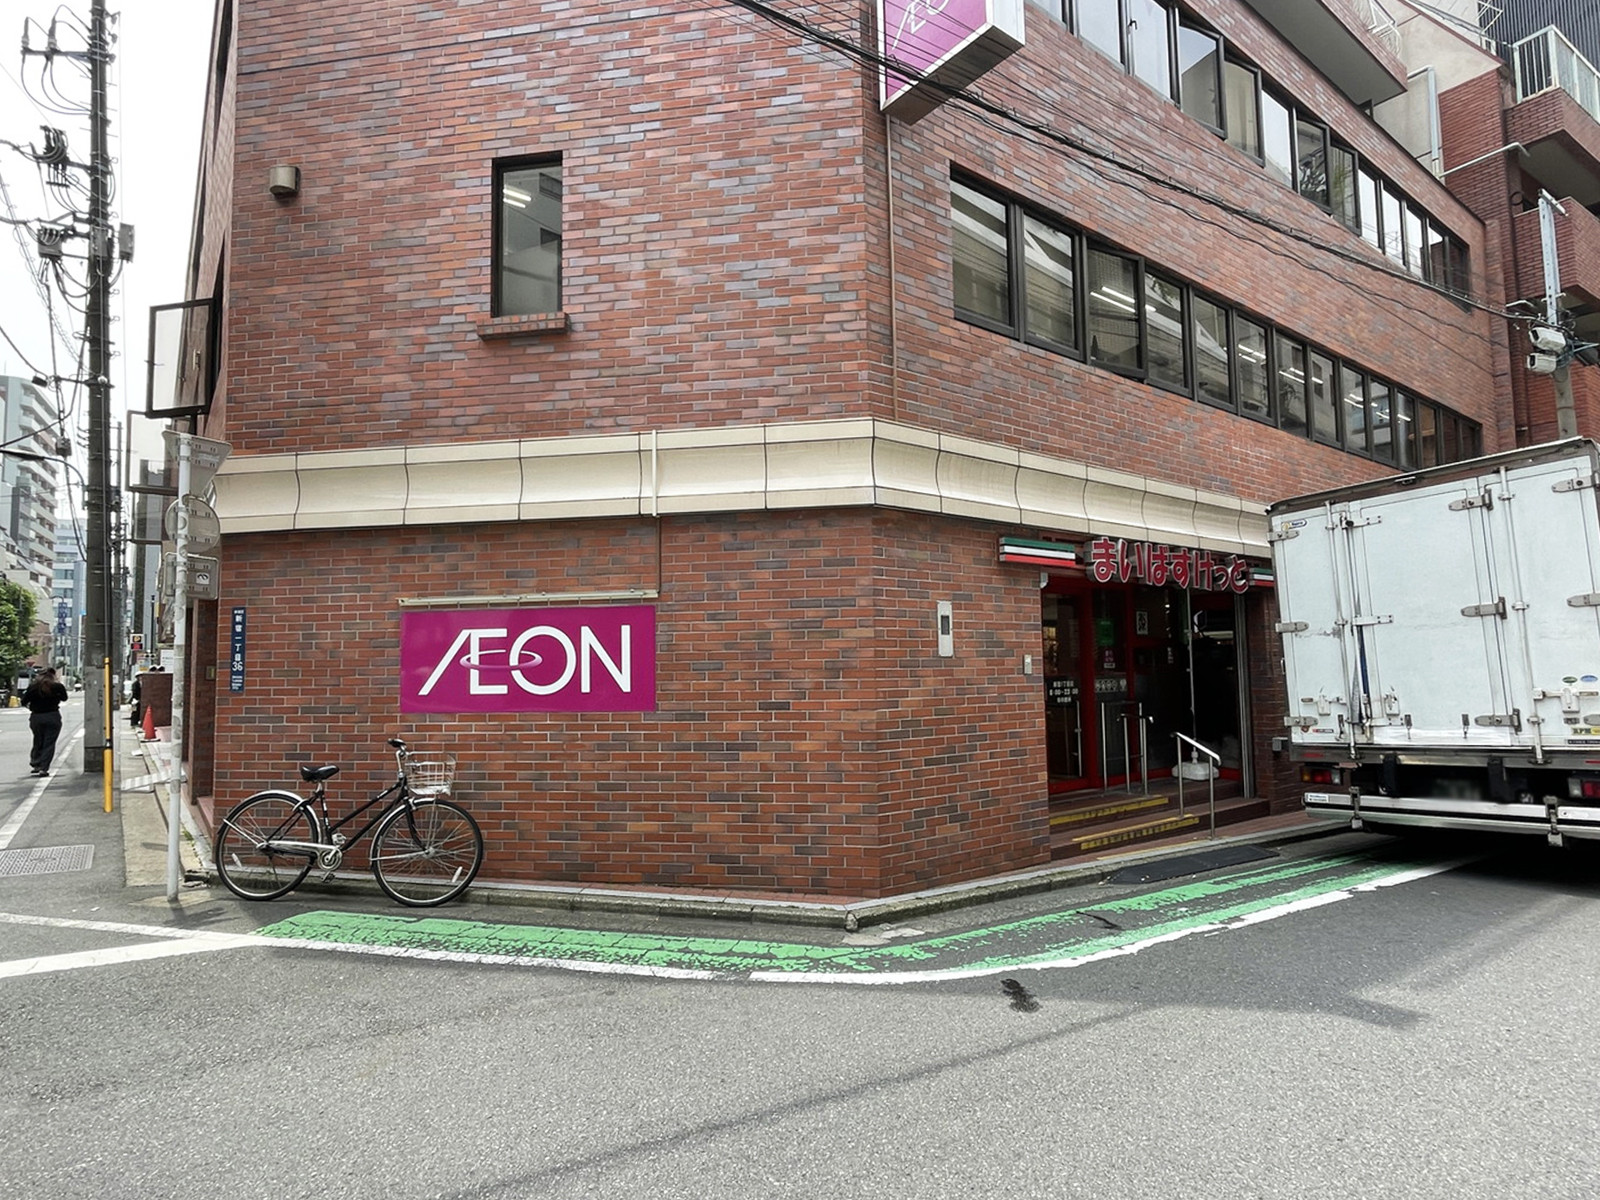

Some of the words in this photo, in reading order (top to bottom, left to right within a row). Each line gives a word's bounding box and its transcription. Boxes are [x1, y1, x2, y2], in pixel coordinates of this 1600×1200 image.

[1090, 537, 1249, 594] まいばすけっと
